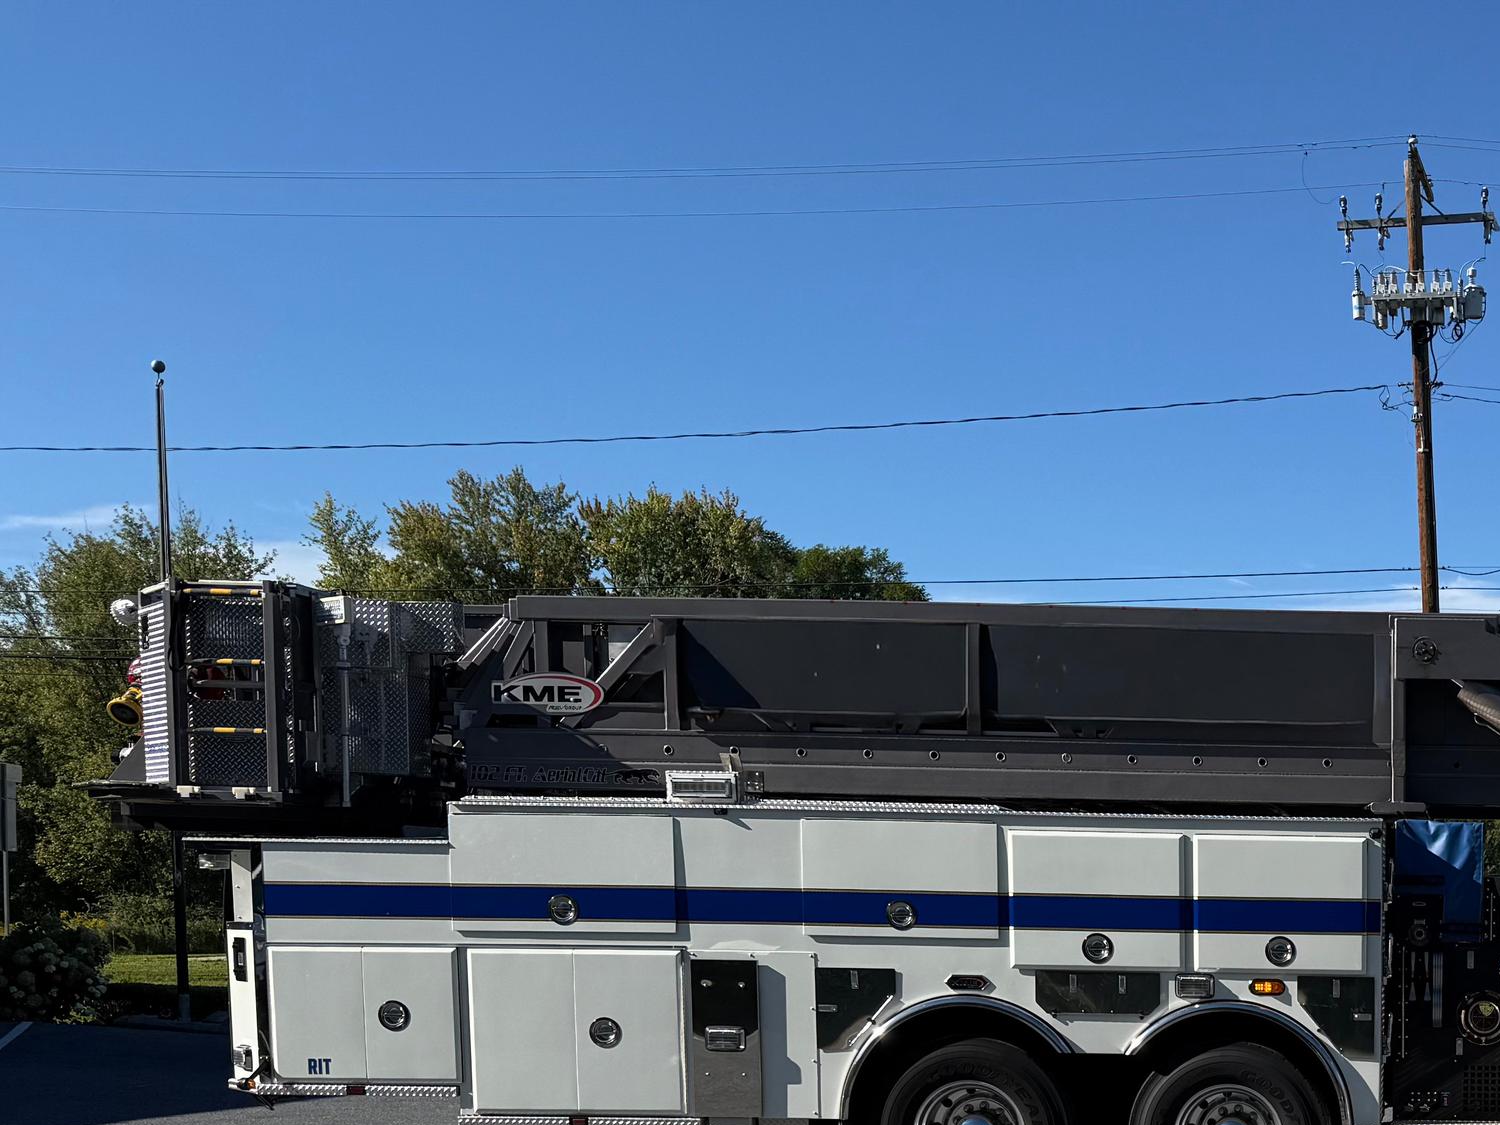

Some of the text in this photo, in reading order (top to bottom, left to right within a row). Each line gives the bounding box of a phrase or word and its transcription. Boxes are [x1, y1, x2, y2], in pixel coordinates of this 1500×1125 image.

[493, 684, 583, 703] KME
[470, 764, 500, 782] 102
[307, 1058, 332, 1075] RIT
